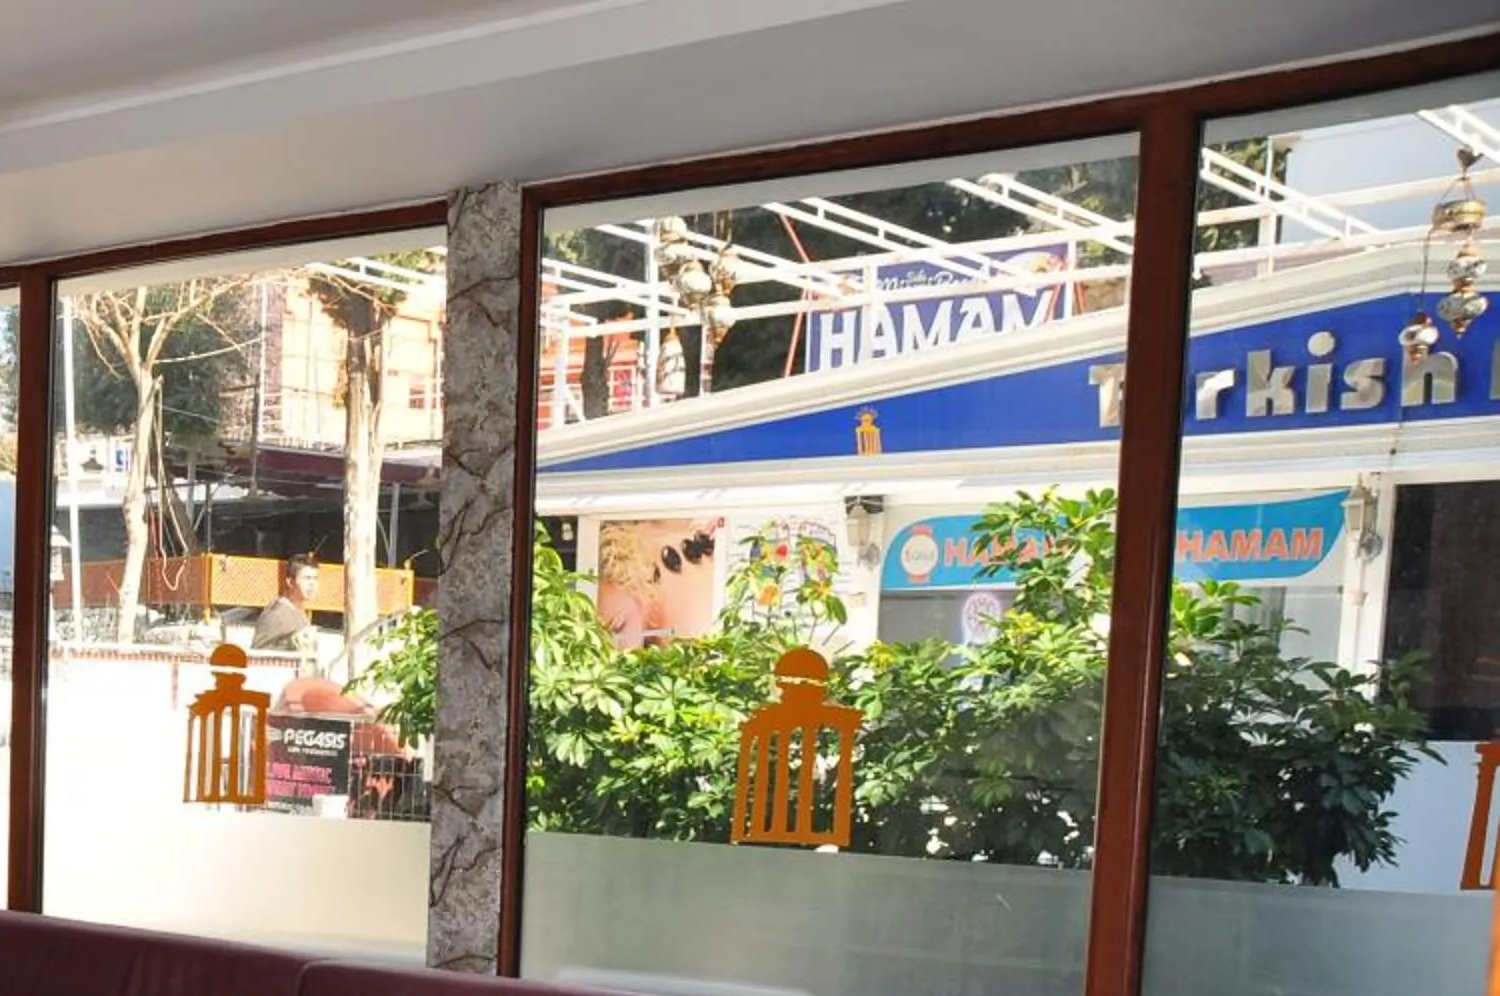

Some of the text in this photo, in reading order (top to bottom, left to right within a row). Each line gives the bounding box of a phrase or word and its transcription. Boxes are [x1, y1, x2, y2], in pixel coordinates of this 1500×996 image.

[818, 289, 1054, 374] HAMAM
[1089, 331, 1458, 428] Trkish
[1176, 527, 1324, 562] HAMAM
